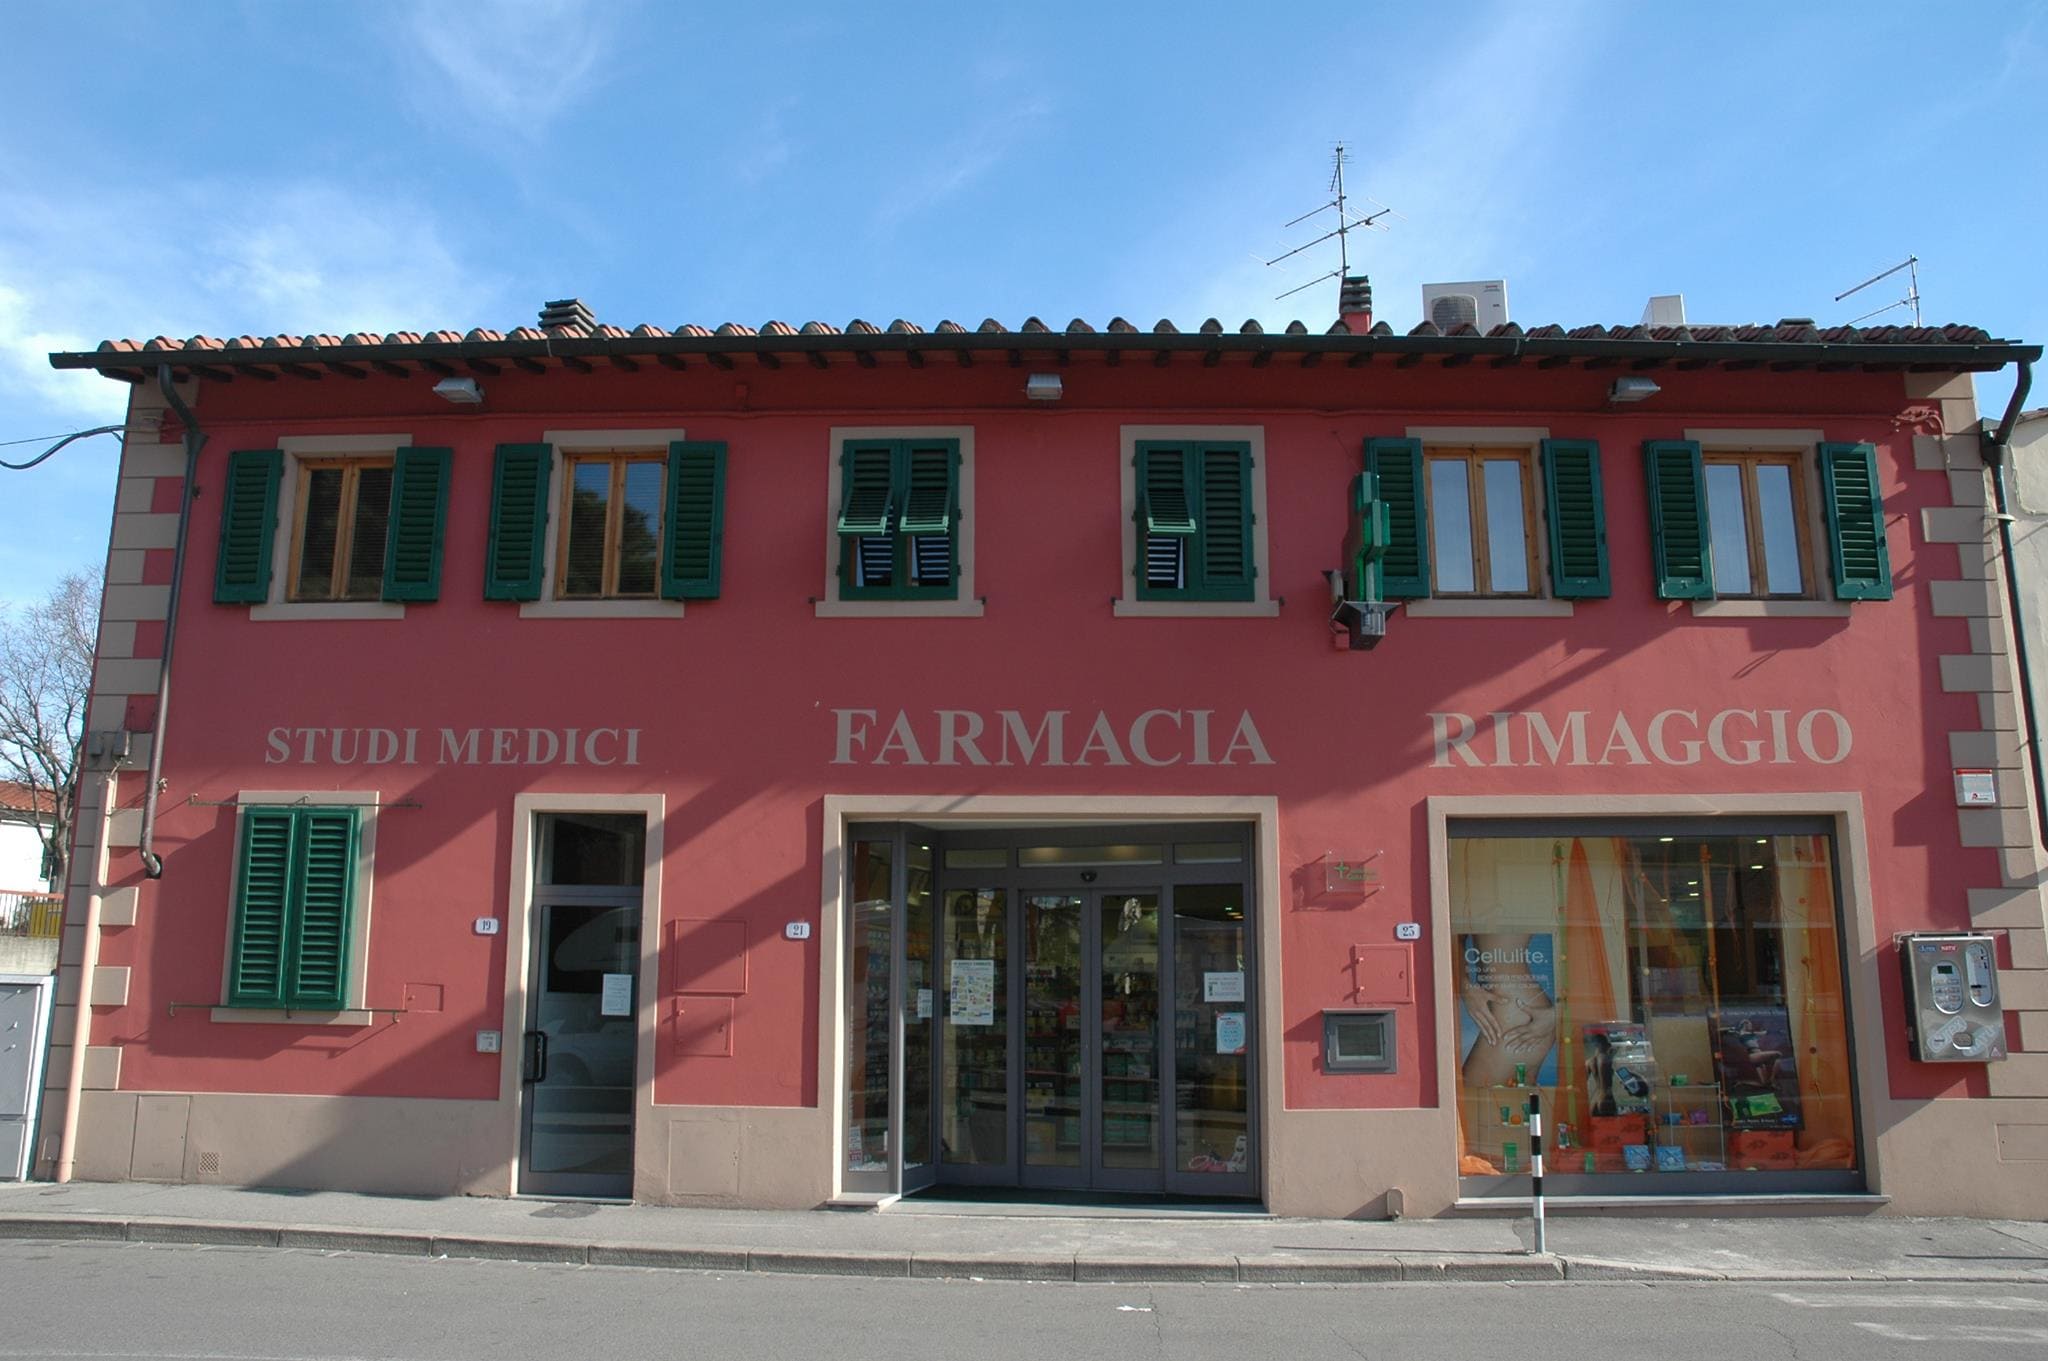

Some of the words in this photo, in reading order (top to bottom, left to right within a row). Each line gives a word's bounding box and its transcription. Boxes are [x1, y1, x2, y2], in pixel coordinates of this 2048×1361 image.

[265, 727, 418, 765] STUDI
[439, 727, 641, 766] MEDICI
[832, 708, 1276, 767] FARMACIA
[1428, 707, 1854, 769] RIMAGGIO
[482, 920, 491, 931] 19
[793, 924, 803, 936] 21
[1464, 947, 1549, 964] Cellulite.
